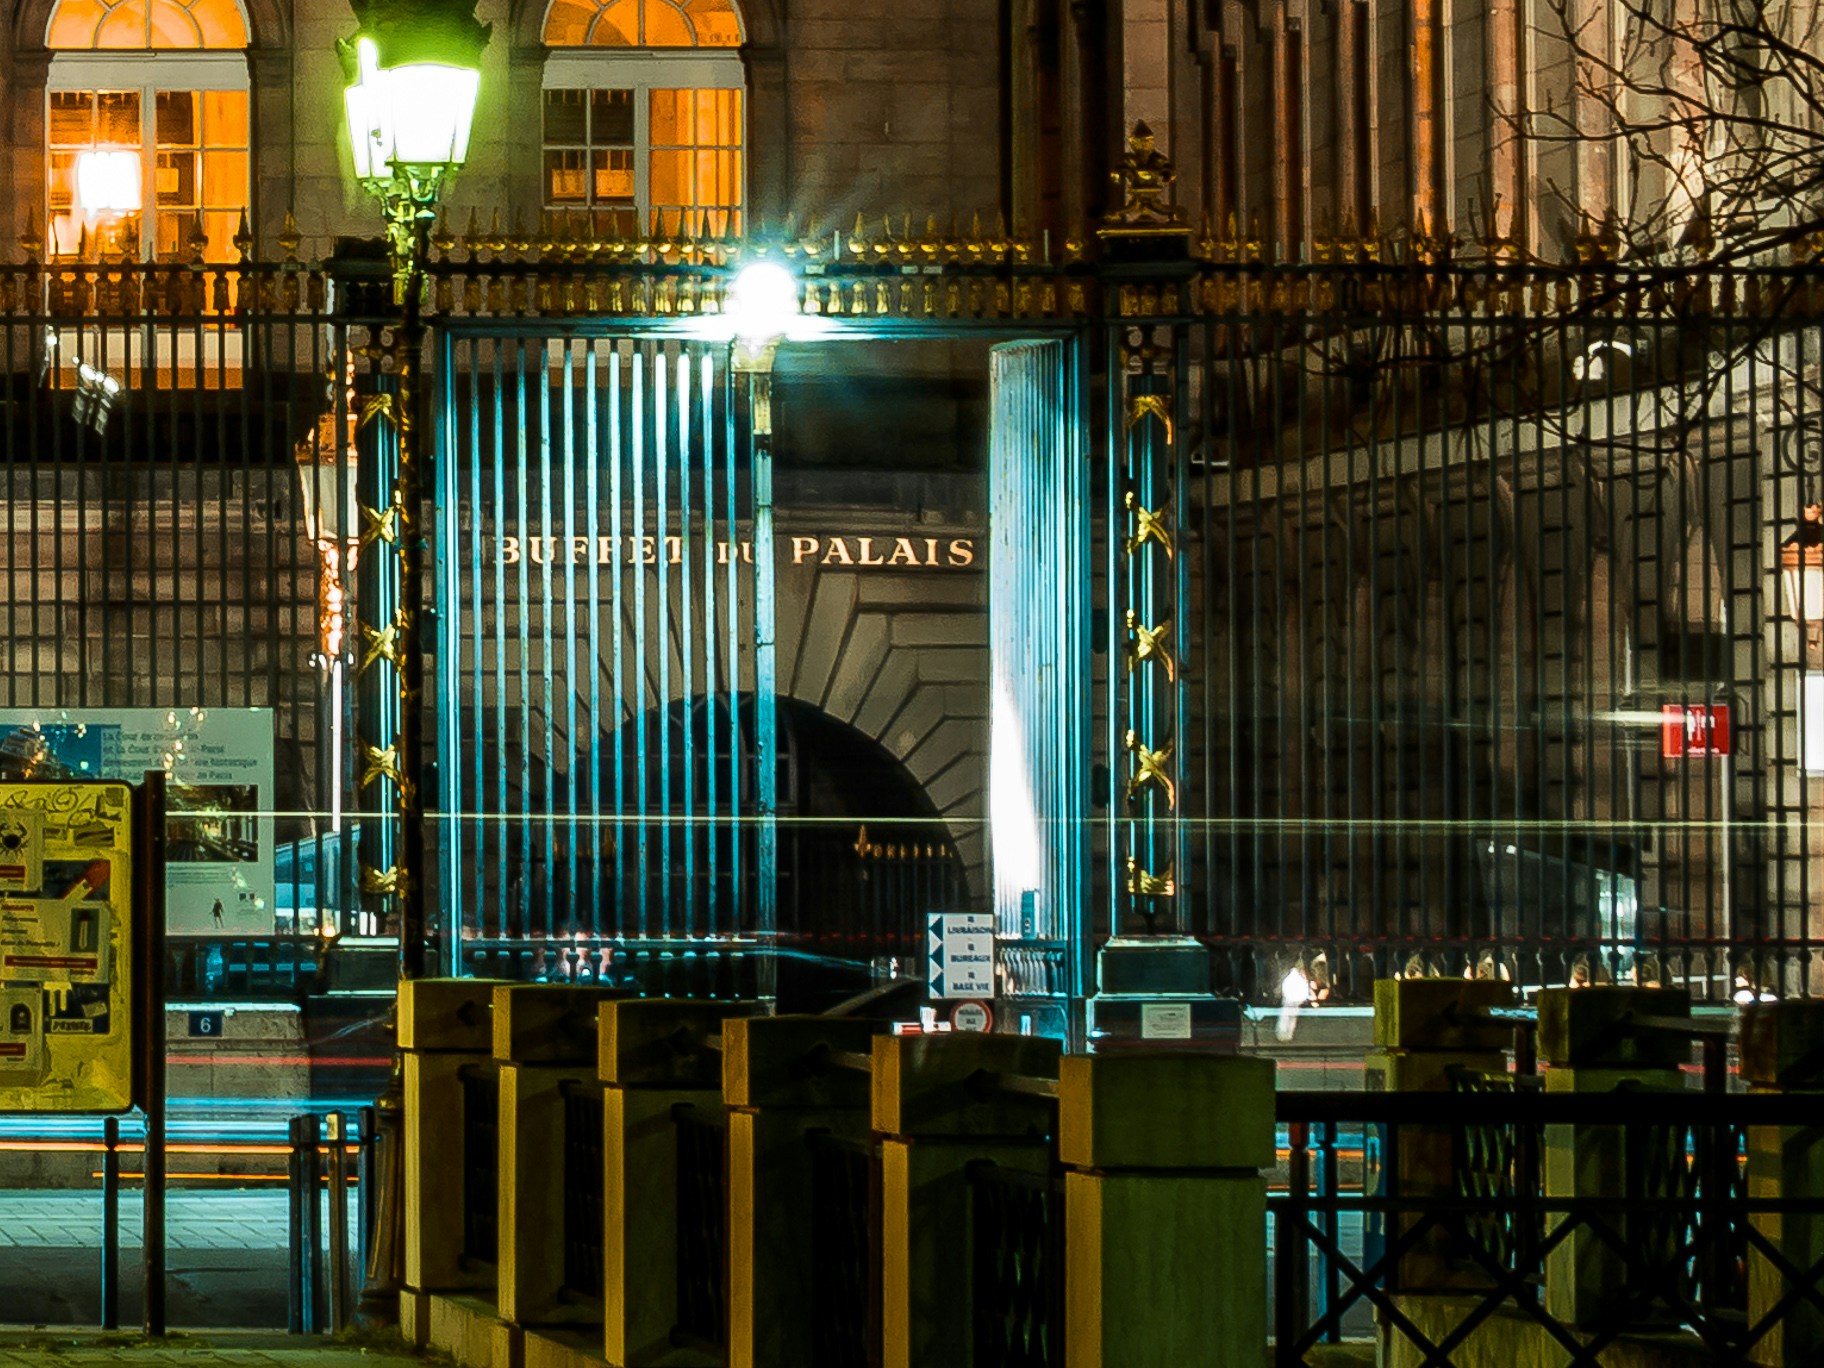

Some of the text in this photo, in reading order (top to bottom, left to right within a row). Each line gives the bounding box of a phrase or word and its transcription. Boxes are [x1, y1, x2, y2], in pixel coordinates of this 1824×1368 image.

[492, 535, 685, 565] BUFFET
[790, 536, 975, 567] PALAIS
[200, 1017, 211, 1033] 6
